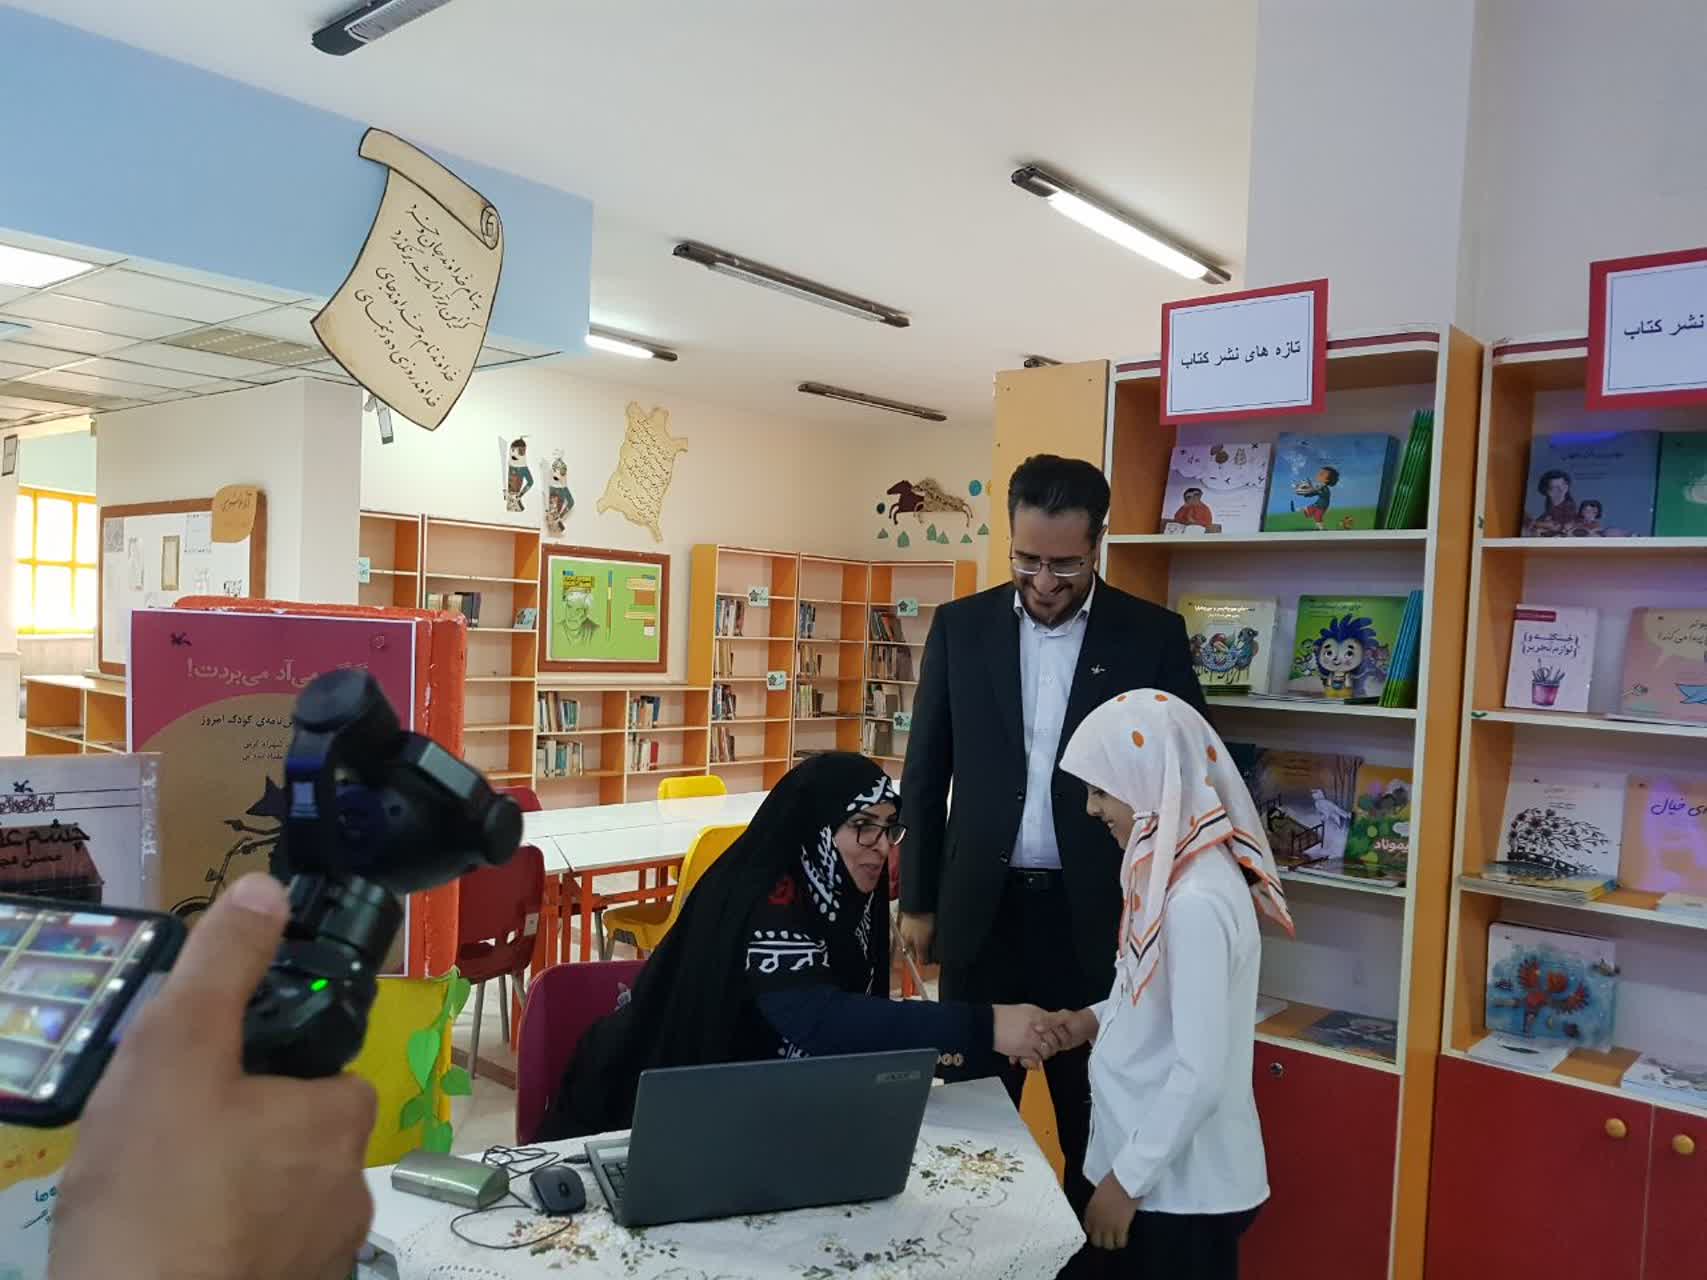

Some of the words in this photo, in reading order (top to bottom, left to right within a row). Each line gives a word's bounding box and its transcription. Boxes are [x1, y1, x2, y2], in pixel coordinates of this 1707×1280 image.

[1623, 319, 1663, 340] کتاب
[1669, 313, 1705, 336] نشر
[1214, 346, 1240, 366] نشر
[1245, 344, 1269, 363] های
[1275, 340, 1301, 359] تازه
[1181, 351, 1210, 369] کتاب
[200, 714, 225, 727] امروز
